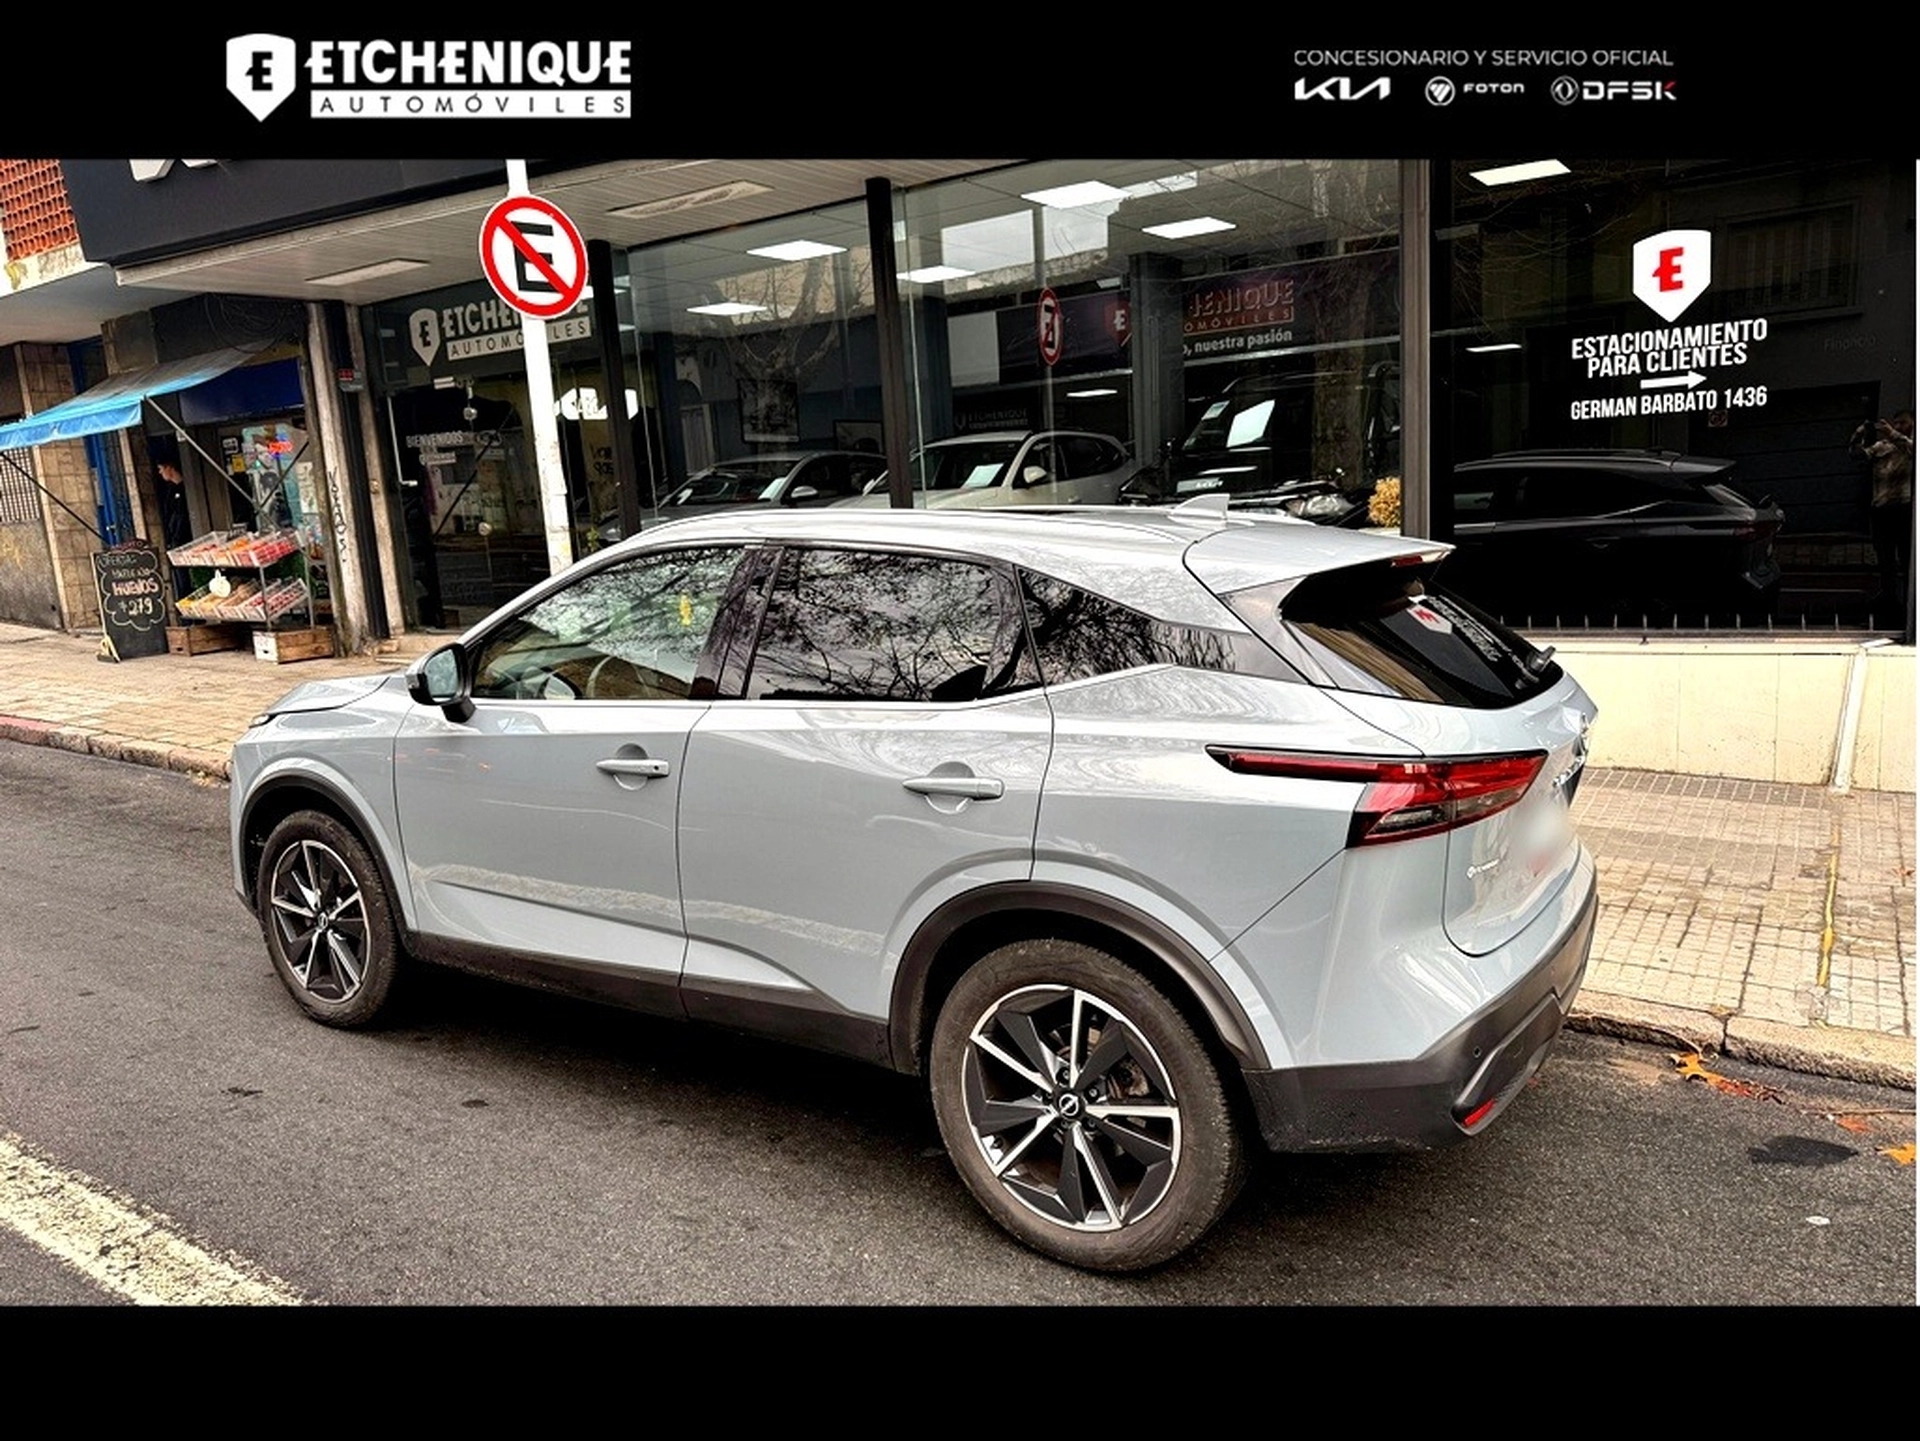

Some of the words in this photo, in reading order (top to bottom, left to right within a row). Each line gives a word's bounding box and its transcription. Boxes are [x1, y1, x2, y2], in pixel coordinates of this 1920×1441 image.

[511, 220, 562, 294] E
[1652, 247, 1684, 293] E
[1194, 336, 1245, 353] nuestra
[1247, 328, 1293, 350] pasión
[1571, 317, 1768, 360] ESTACIONAMIENTO
[1587, 353, 1641, 379] PARA
[1646, 342, 1748, 373] CLIENTES
[1570, 396, 1637, 420] GERMAN
[1640, 389, 1718, 415] BARBATO
[1724, 385, 1768, 409] 1436
